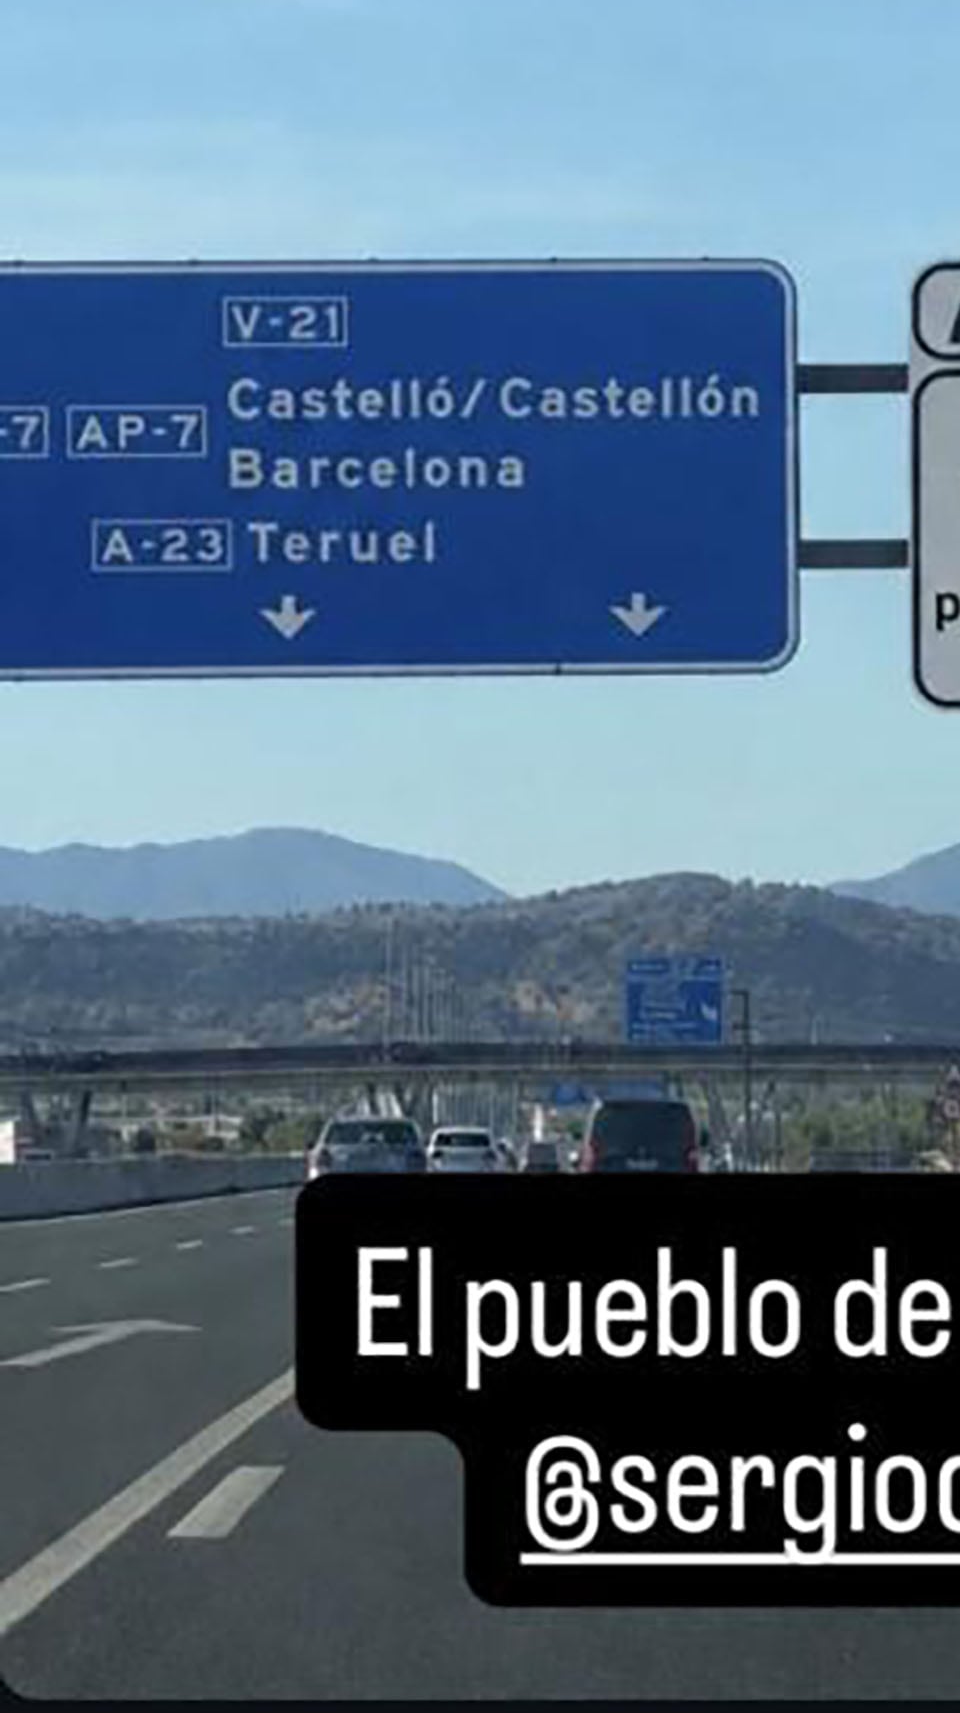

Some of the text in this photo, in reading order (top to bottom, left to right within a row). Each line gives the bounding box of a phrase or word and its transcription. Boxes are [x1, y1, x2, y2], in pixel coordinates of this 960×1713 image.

[231, 305, 339, 340] V-21
[77, 414, 198, 449] AP-7
[228, 447, 525, 489] Barcelona
[102, 528, 223, 562] A-23
[248, 521, 435, 563] Teruel
